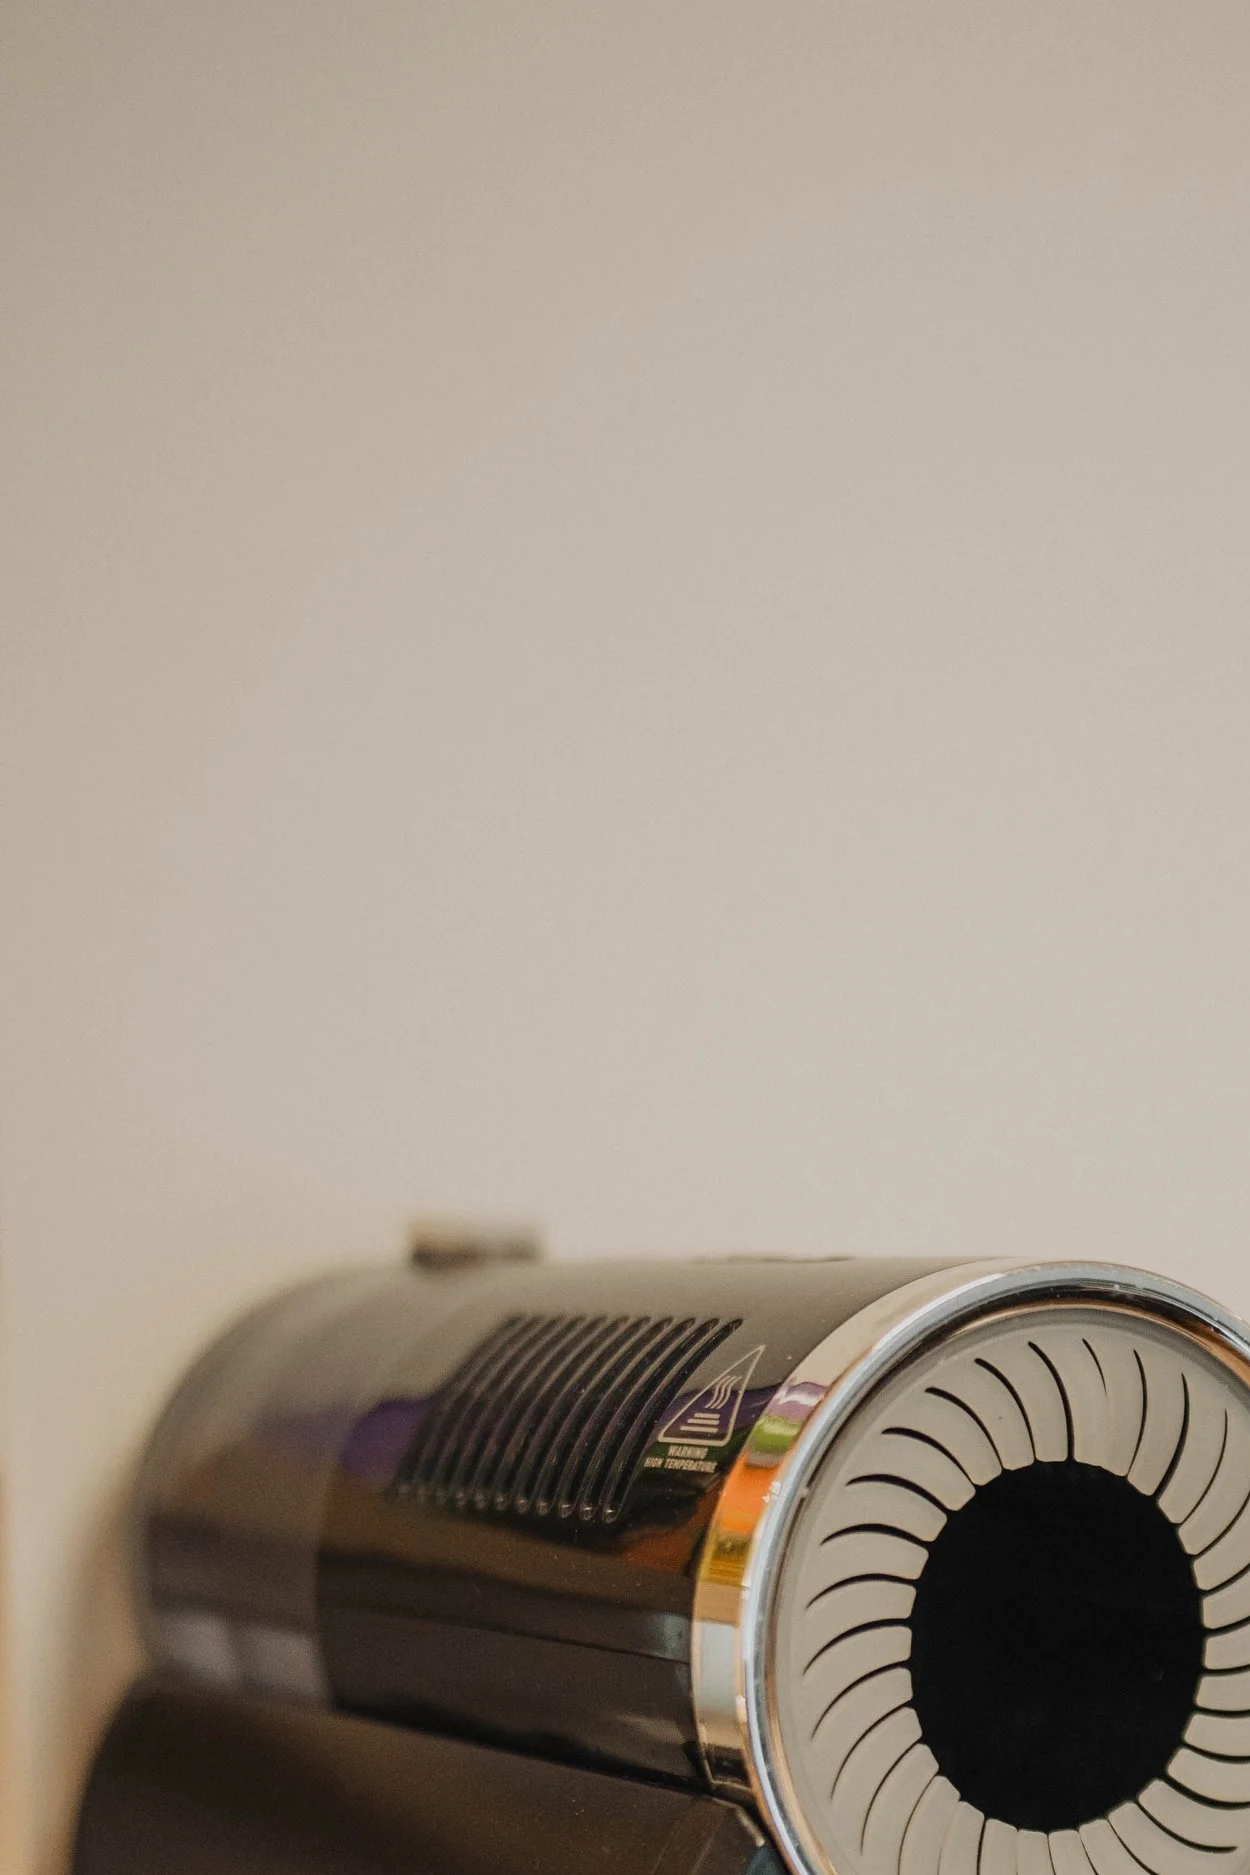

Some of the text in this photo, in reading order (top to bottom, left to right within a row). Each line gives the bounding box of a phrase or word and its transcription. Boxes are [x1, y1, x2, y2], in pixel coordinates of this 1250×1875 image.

[668, 1445, 708, 1459] WARNING
[644, 1457, 717, 1473] HIGH TEMPERATURE
